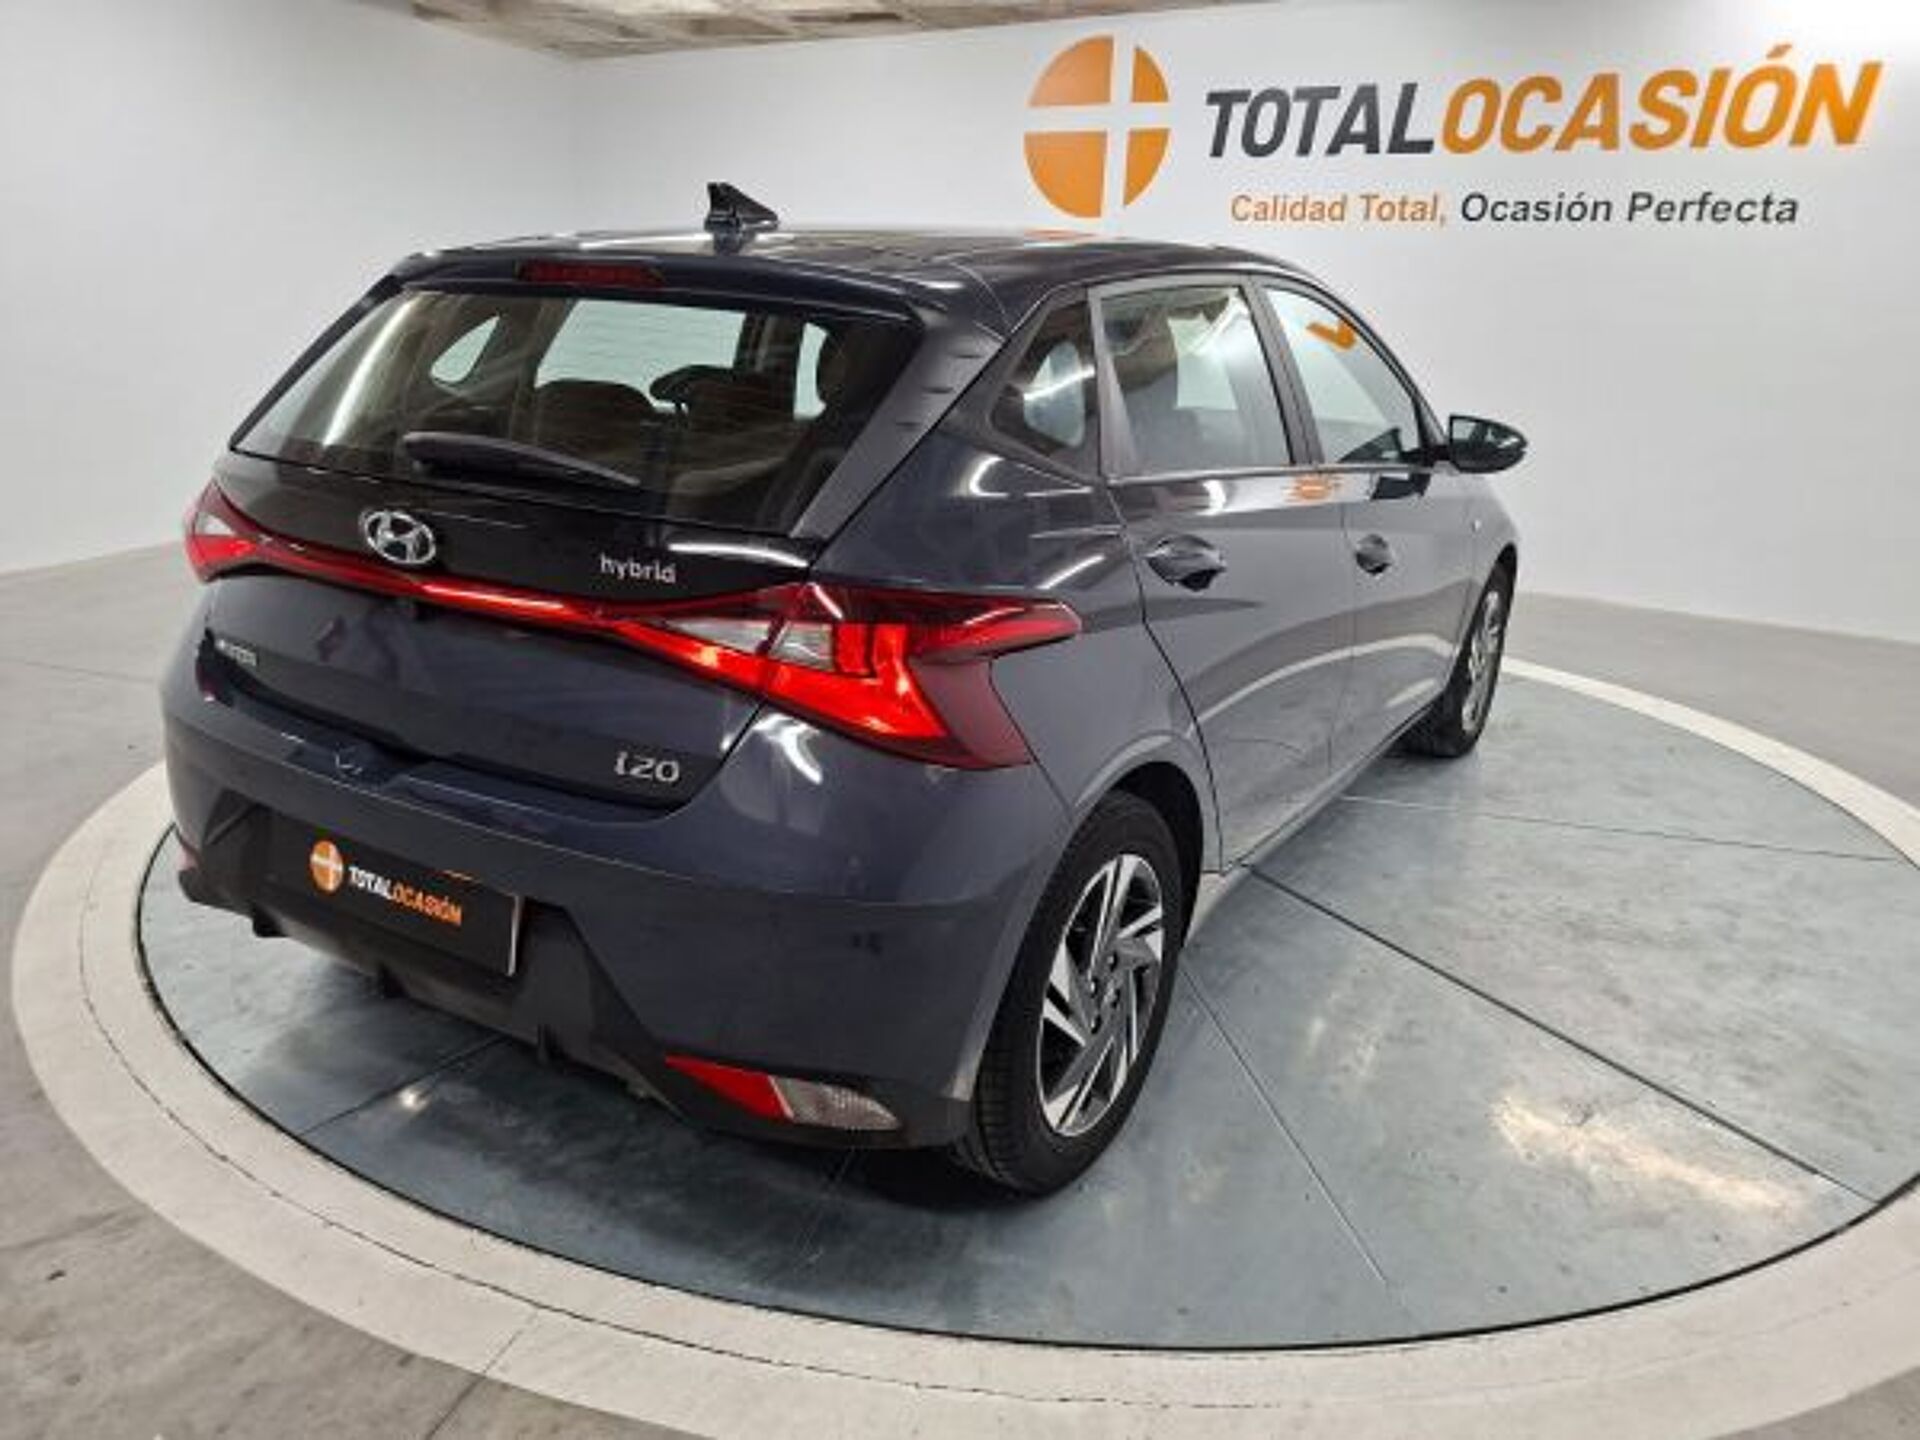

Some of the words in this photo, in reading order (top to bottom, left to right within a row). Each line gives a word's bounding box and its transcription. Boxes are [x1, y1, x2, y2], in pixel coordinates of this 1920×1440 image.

[1231, 194, 1348, 222] Calidad
[1360, 194, 1446, 226] Total,
[1461, 192, 1613, 222] Ocasión
[1625, 190, 1799, 222] Perfecta
[600, 552, 676, 583] hybrid
